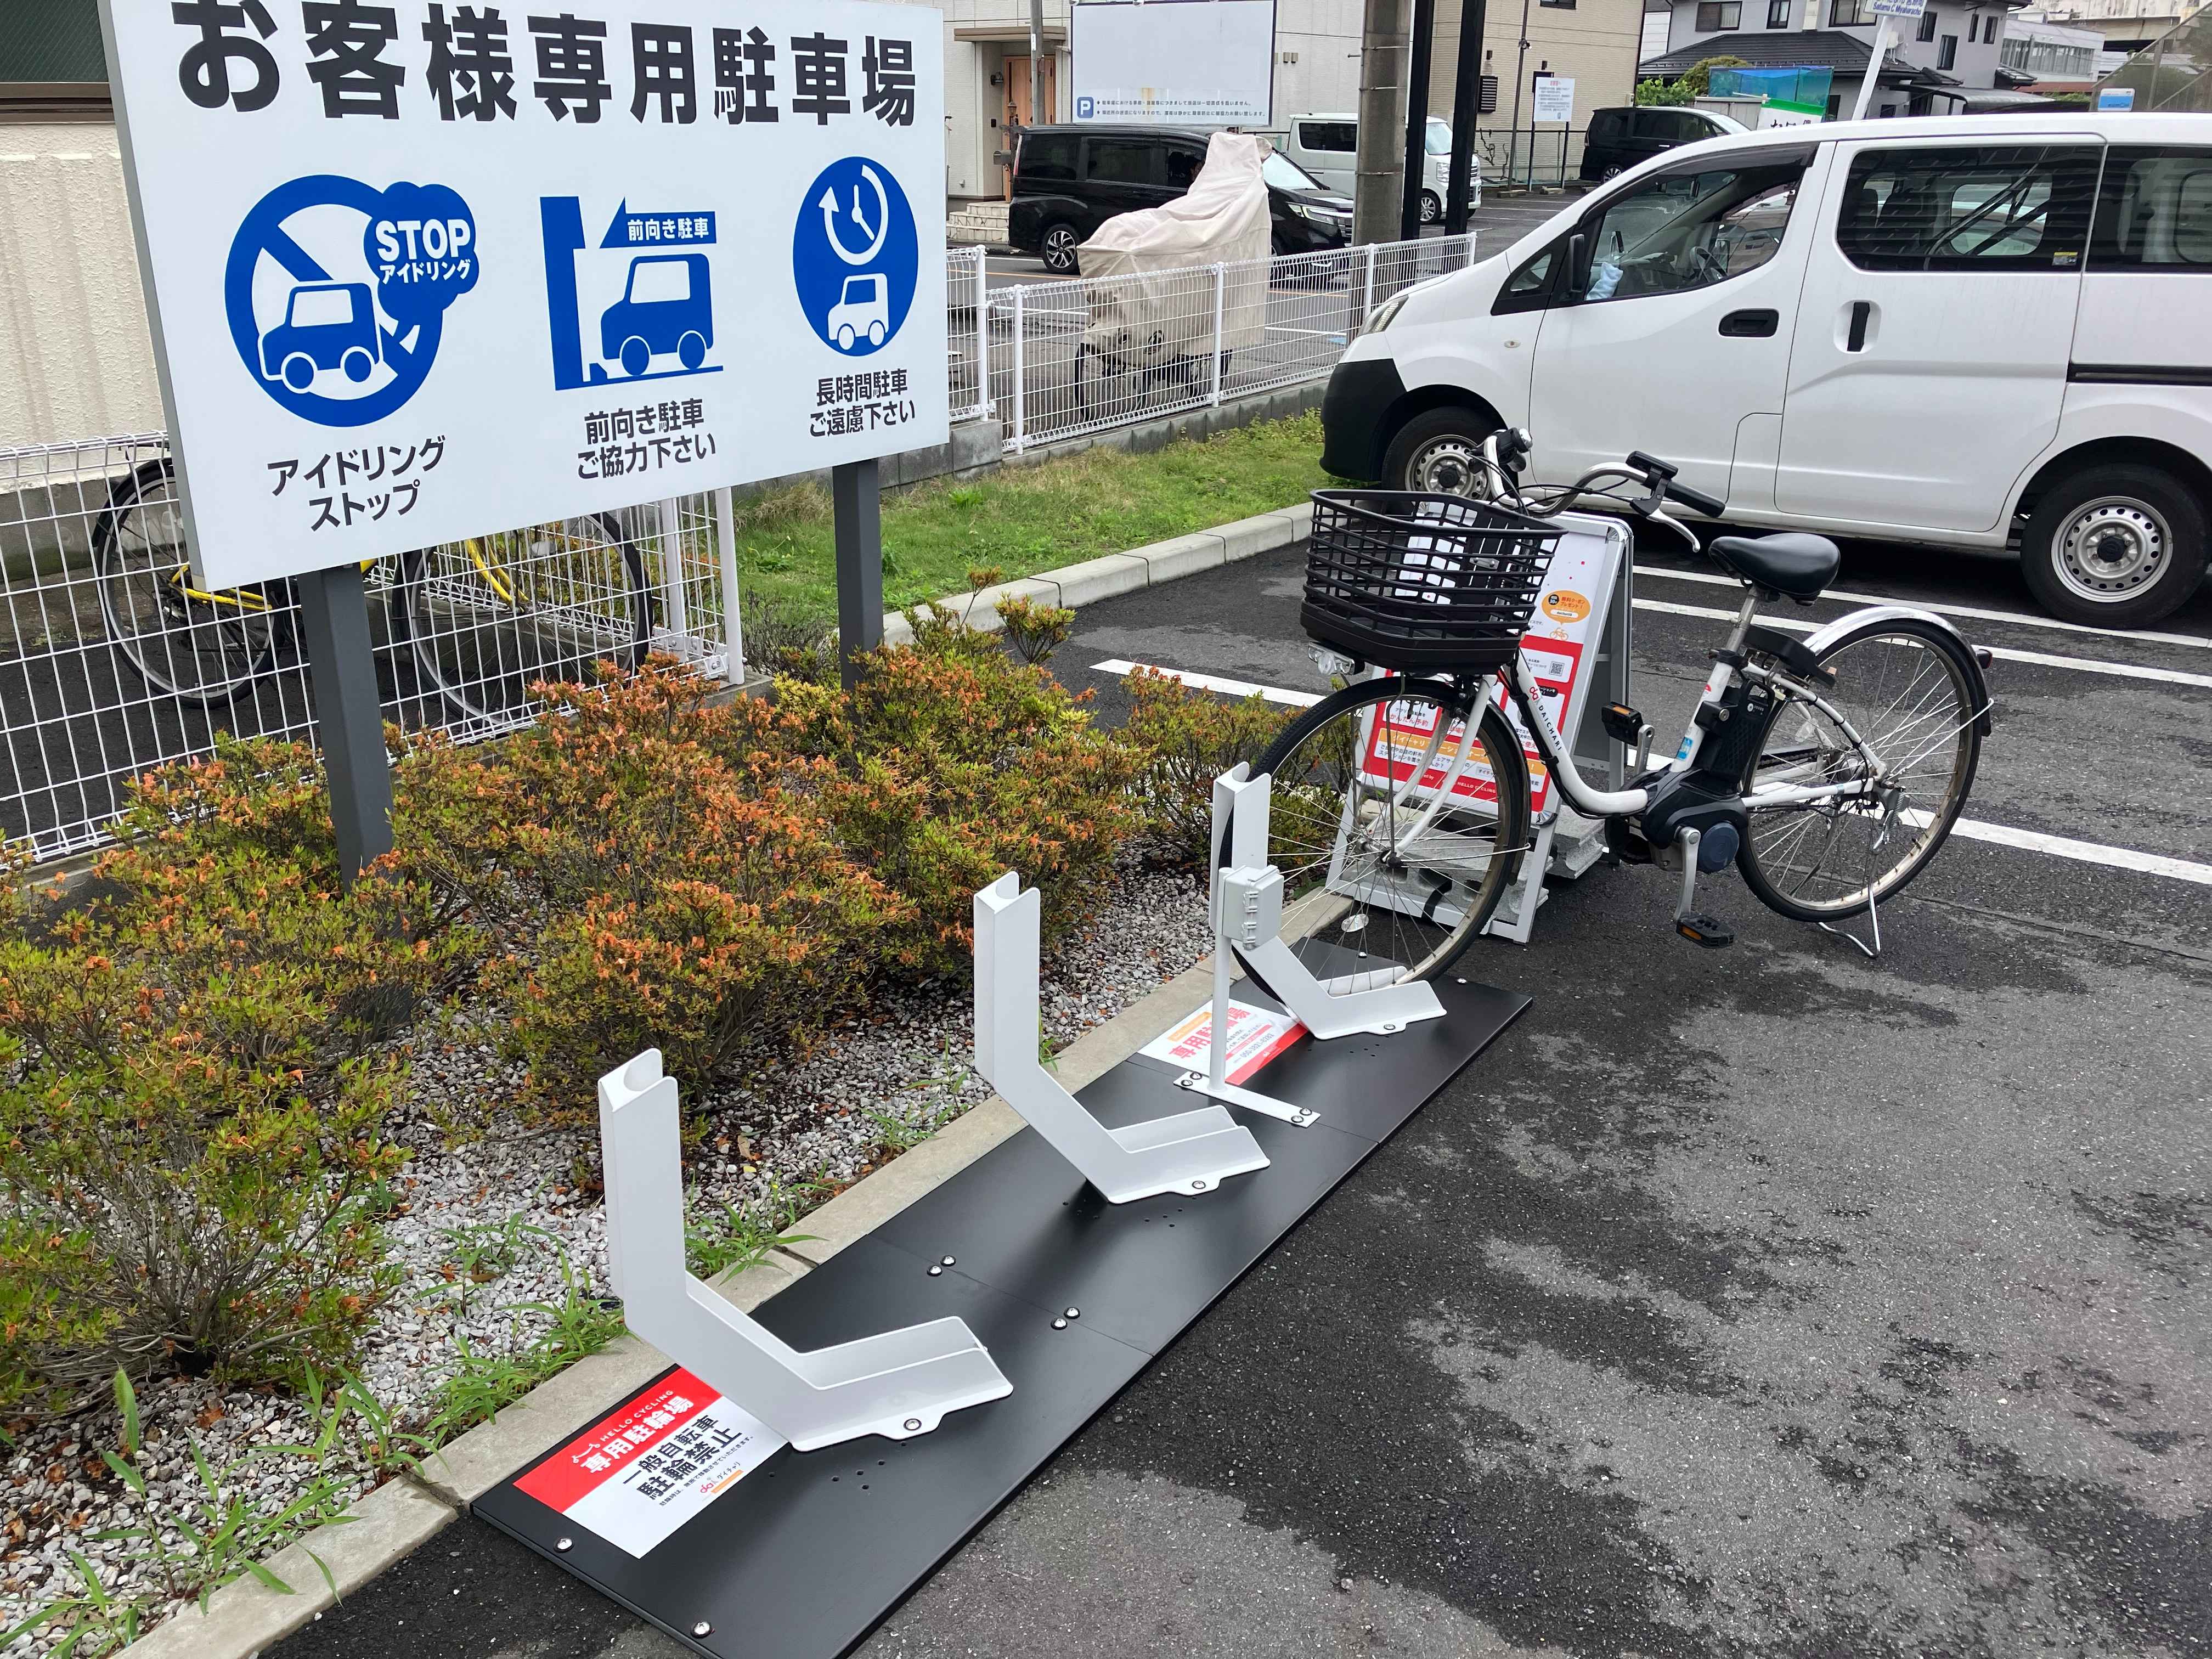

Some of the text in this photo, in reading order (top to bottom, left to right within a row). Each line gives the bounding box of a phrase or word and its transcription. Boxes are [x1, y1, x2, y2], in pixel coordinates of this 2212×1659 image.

[171, 0, 916, 127] お客様専用駐車場
[1080, 100, 1091, 115] P
[375, 218, 471, 261] STOP
[627, 217, 710, 241] 前向き駐車
[379, 258, 472, 285] アイドリング
[816, 368, 908, 407] 長時間駐車
[584, 398, 704, 445] 前向き駐車
[809, 400, 916, 438] ご遠慮下さい
[267, 435, 446, 496] アイドリング
[577, 433, 716, 480] ご協力下さい
[308, 478, 420, 532] ストップ
[1539, 705, 1562, 751] DAICHARI
[580, 1395, 695, 1475] 専用駐輪場
[600, 1390, 674, 1442] HELLO CYCLING
[623, 1415, 719, 1485] 一般自転車
[636, 1426, 742, 1500] 駐輪禁止
